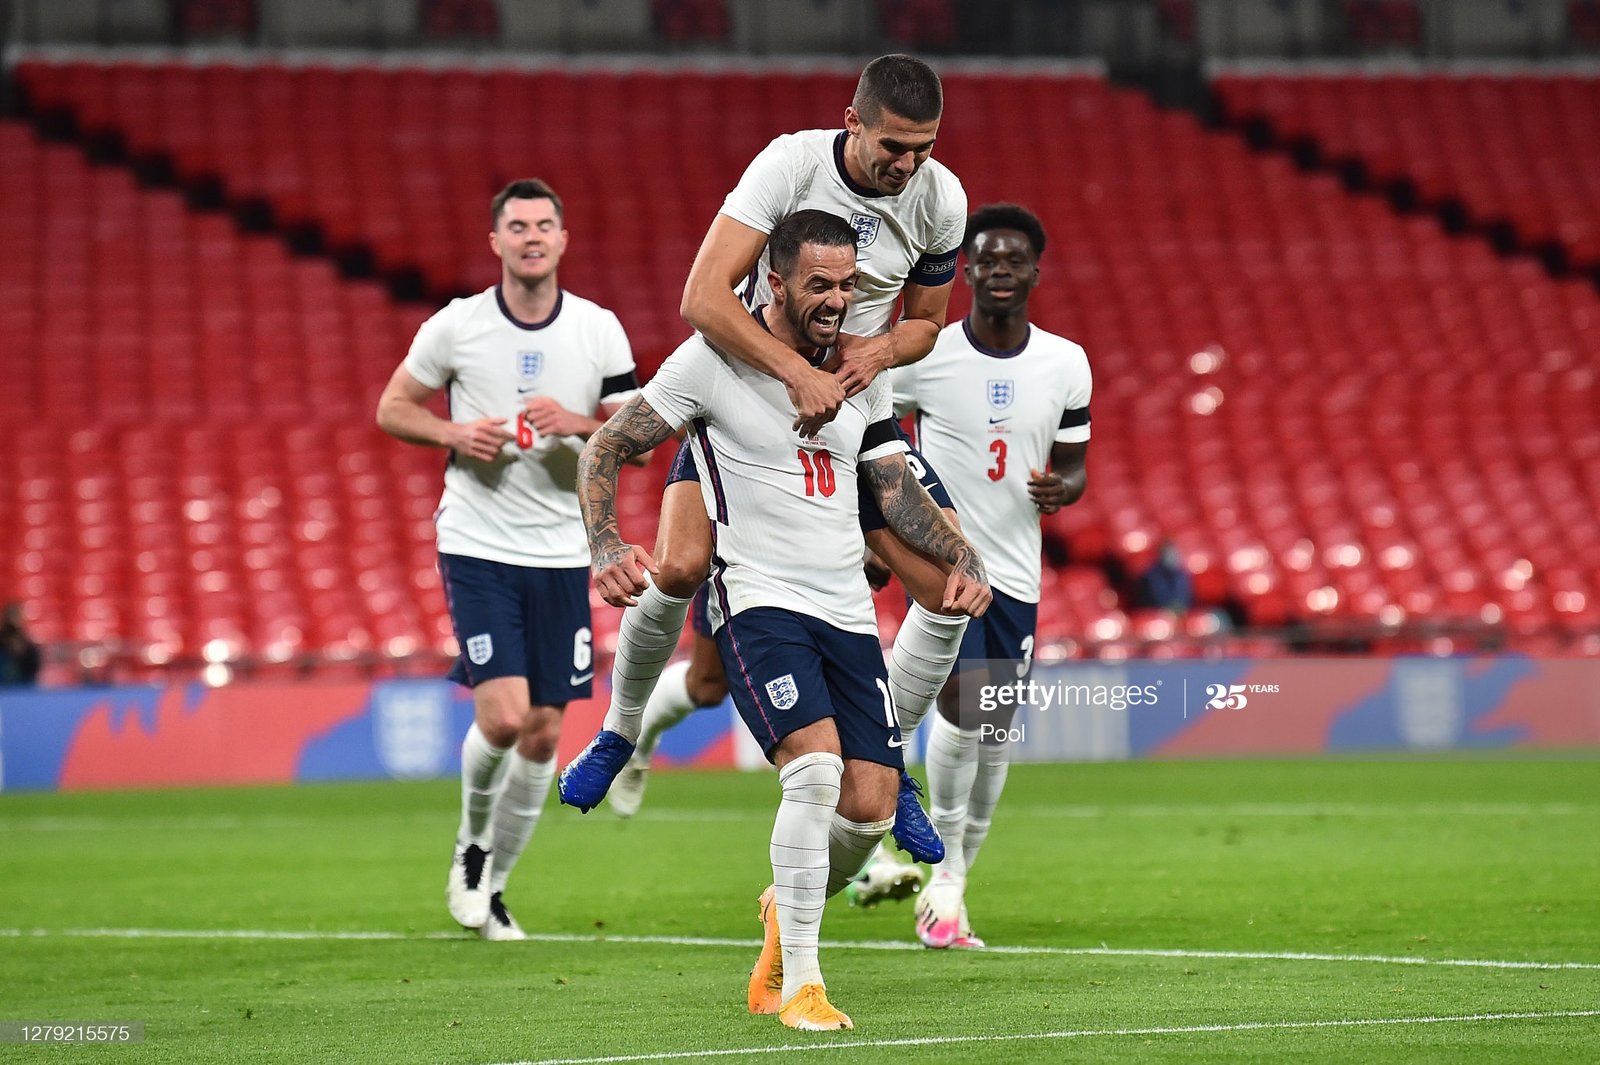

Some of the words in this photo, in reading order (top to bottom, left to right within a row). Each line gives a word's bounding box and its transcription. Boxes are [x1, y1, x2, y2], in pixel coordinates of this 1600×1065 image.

[922, 260, 955, 272] RESPECT
[517, 412, 533, 449] 6
[797, 449, 836, 497] 10
[988, 440, 1007, 481] 3
[574, 627, 592, 671] 6
[1016, 635, 1034, 678] 3
